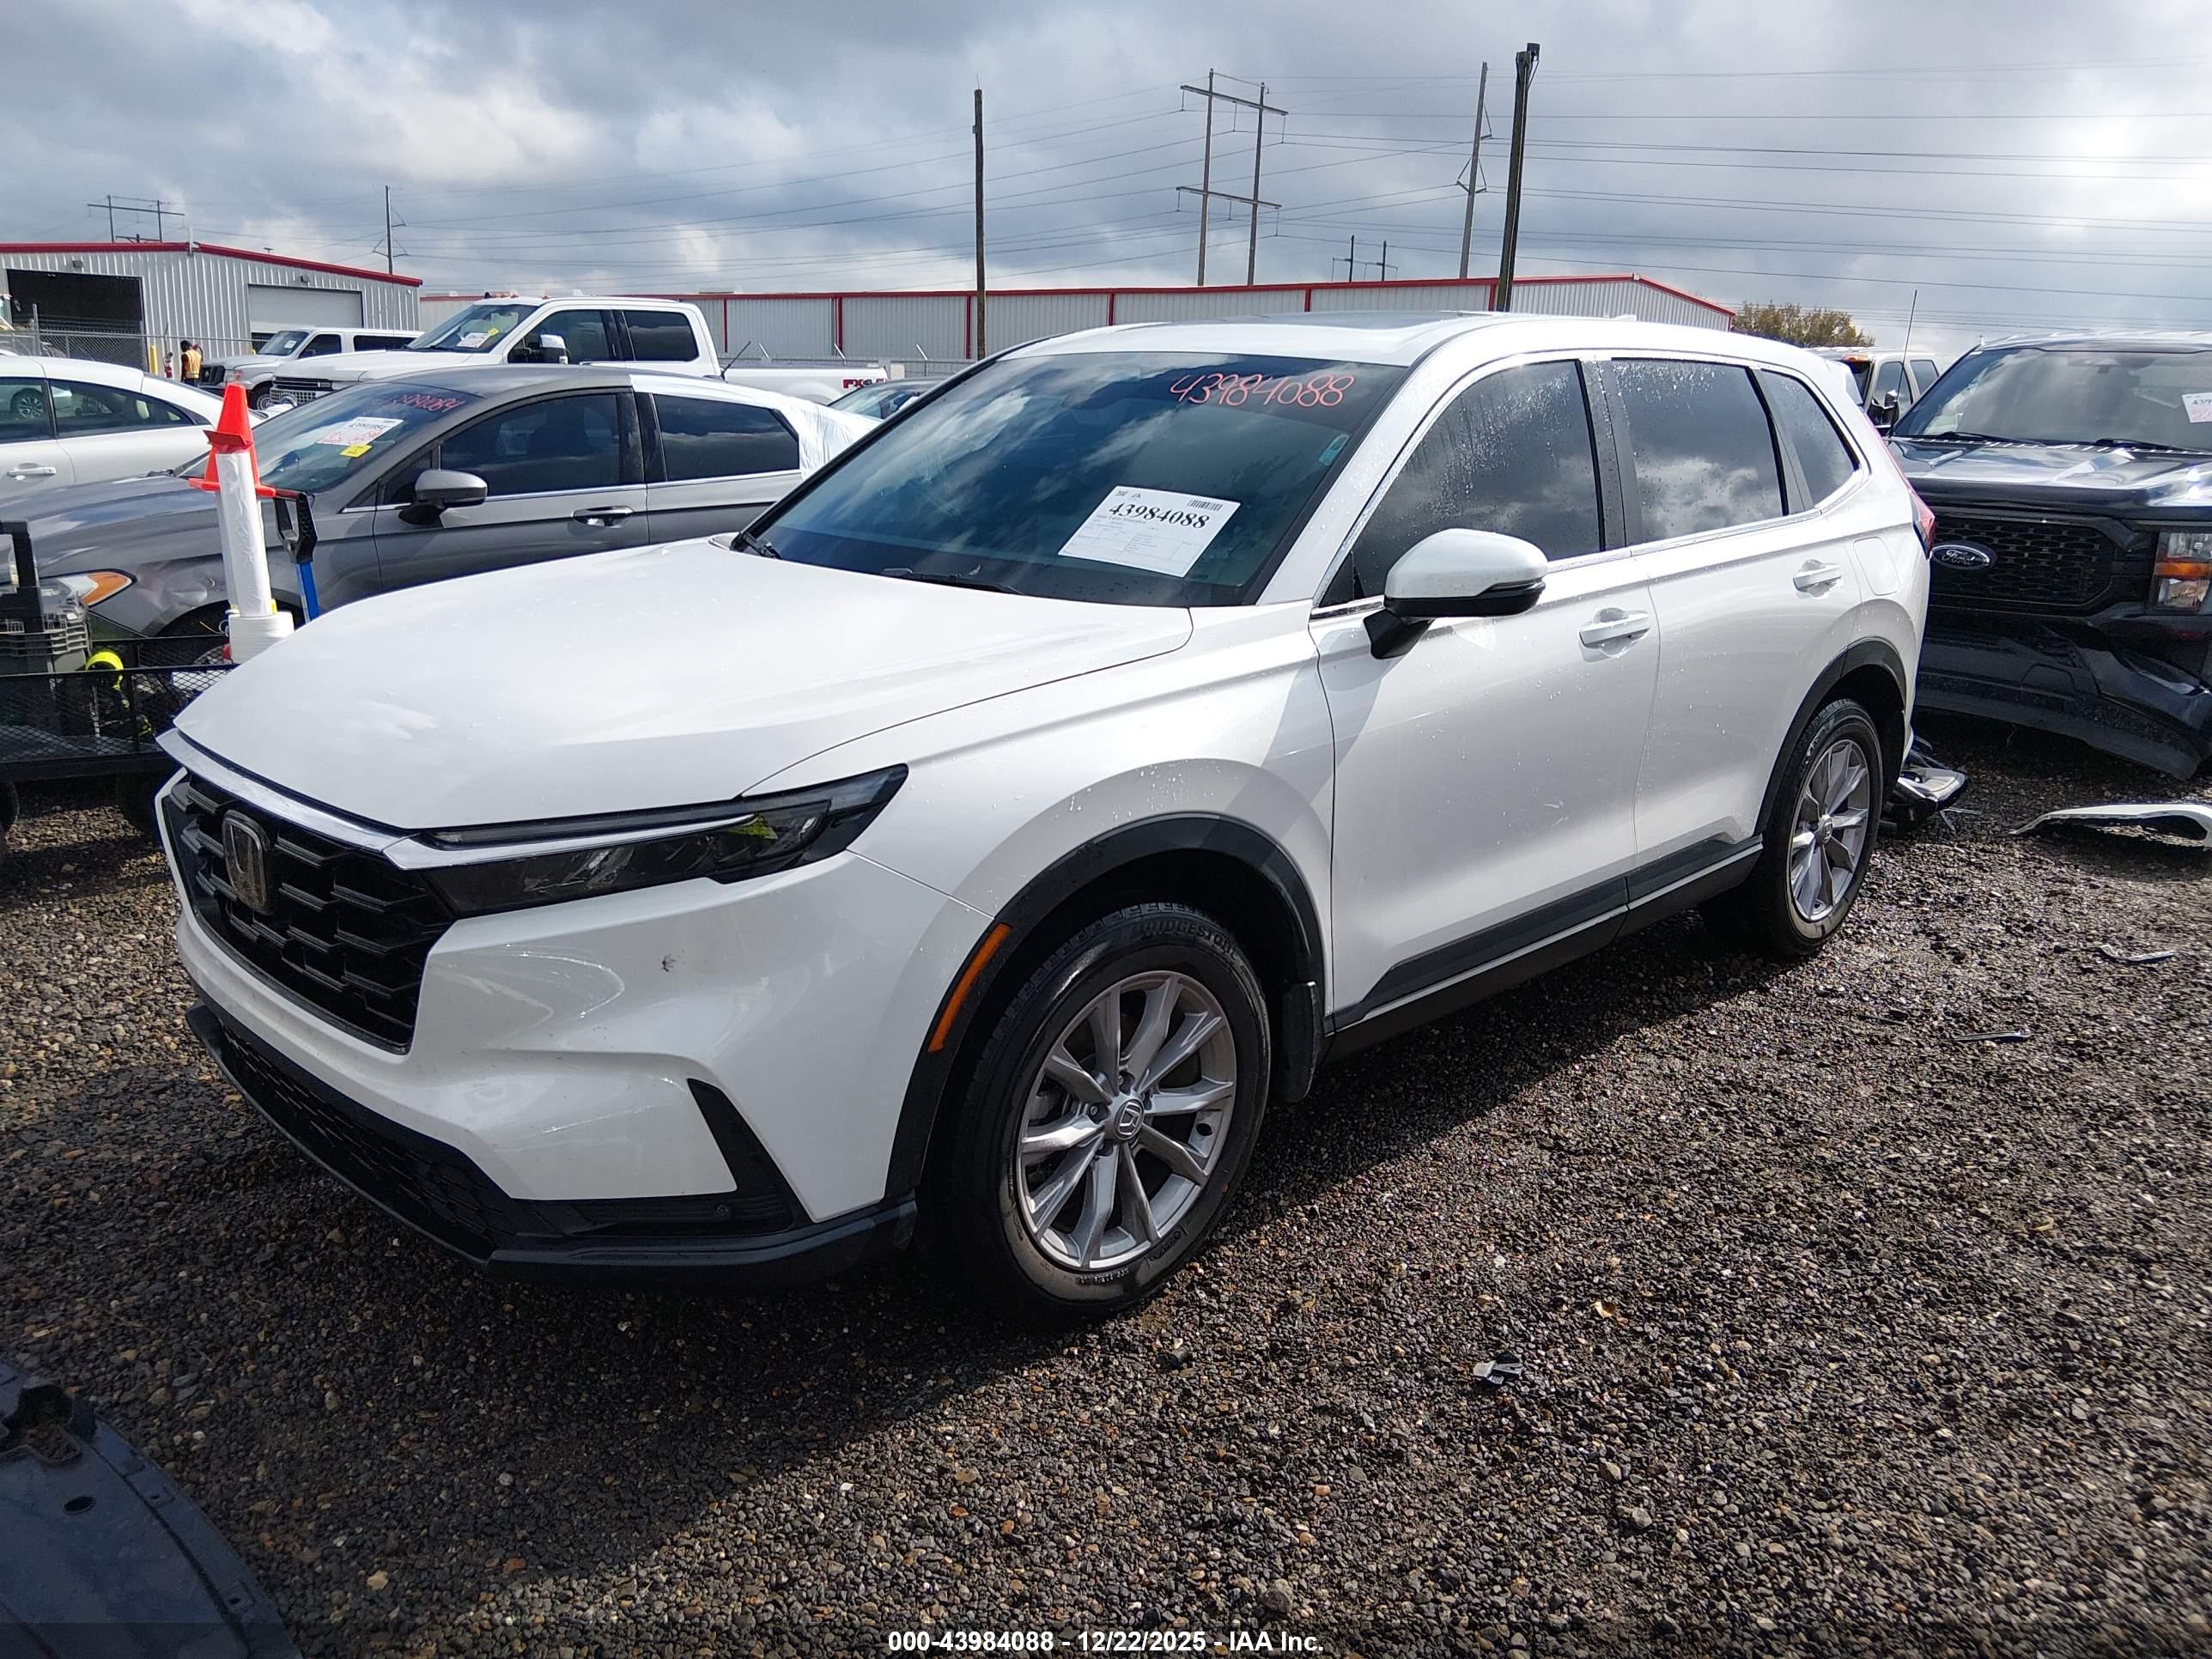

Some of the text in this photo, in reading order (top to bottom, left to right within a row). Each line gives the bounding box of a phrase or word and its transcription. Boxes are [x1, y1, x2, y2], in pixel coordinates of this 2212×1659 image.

[1170, 373, 1355, 407] 43984088
[1109, 502, 1210, 529] 43984088
[1942, 550, 1976, 565] Ford
